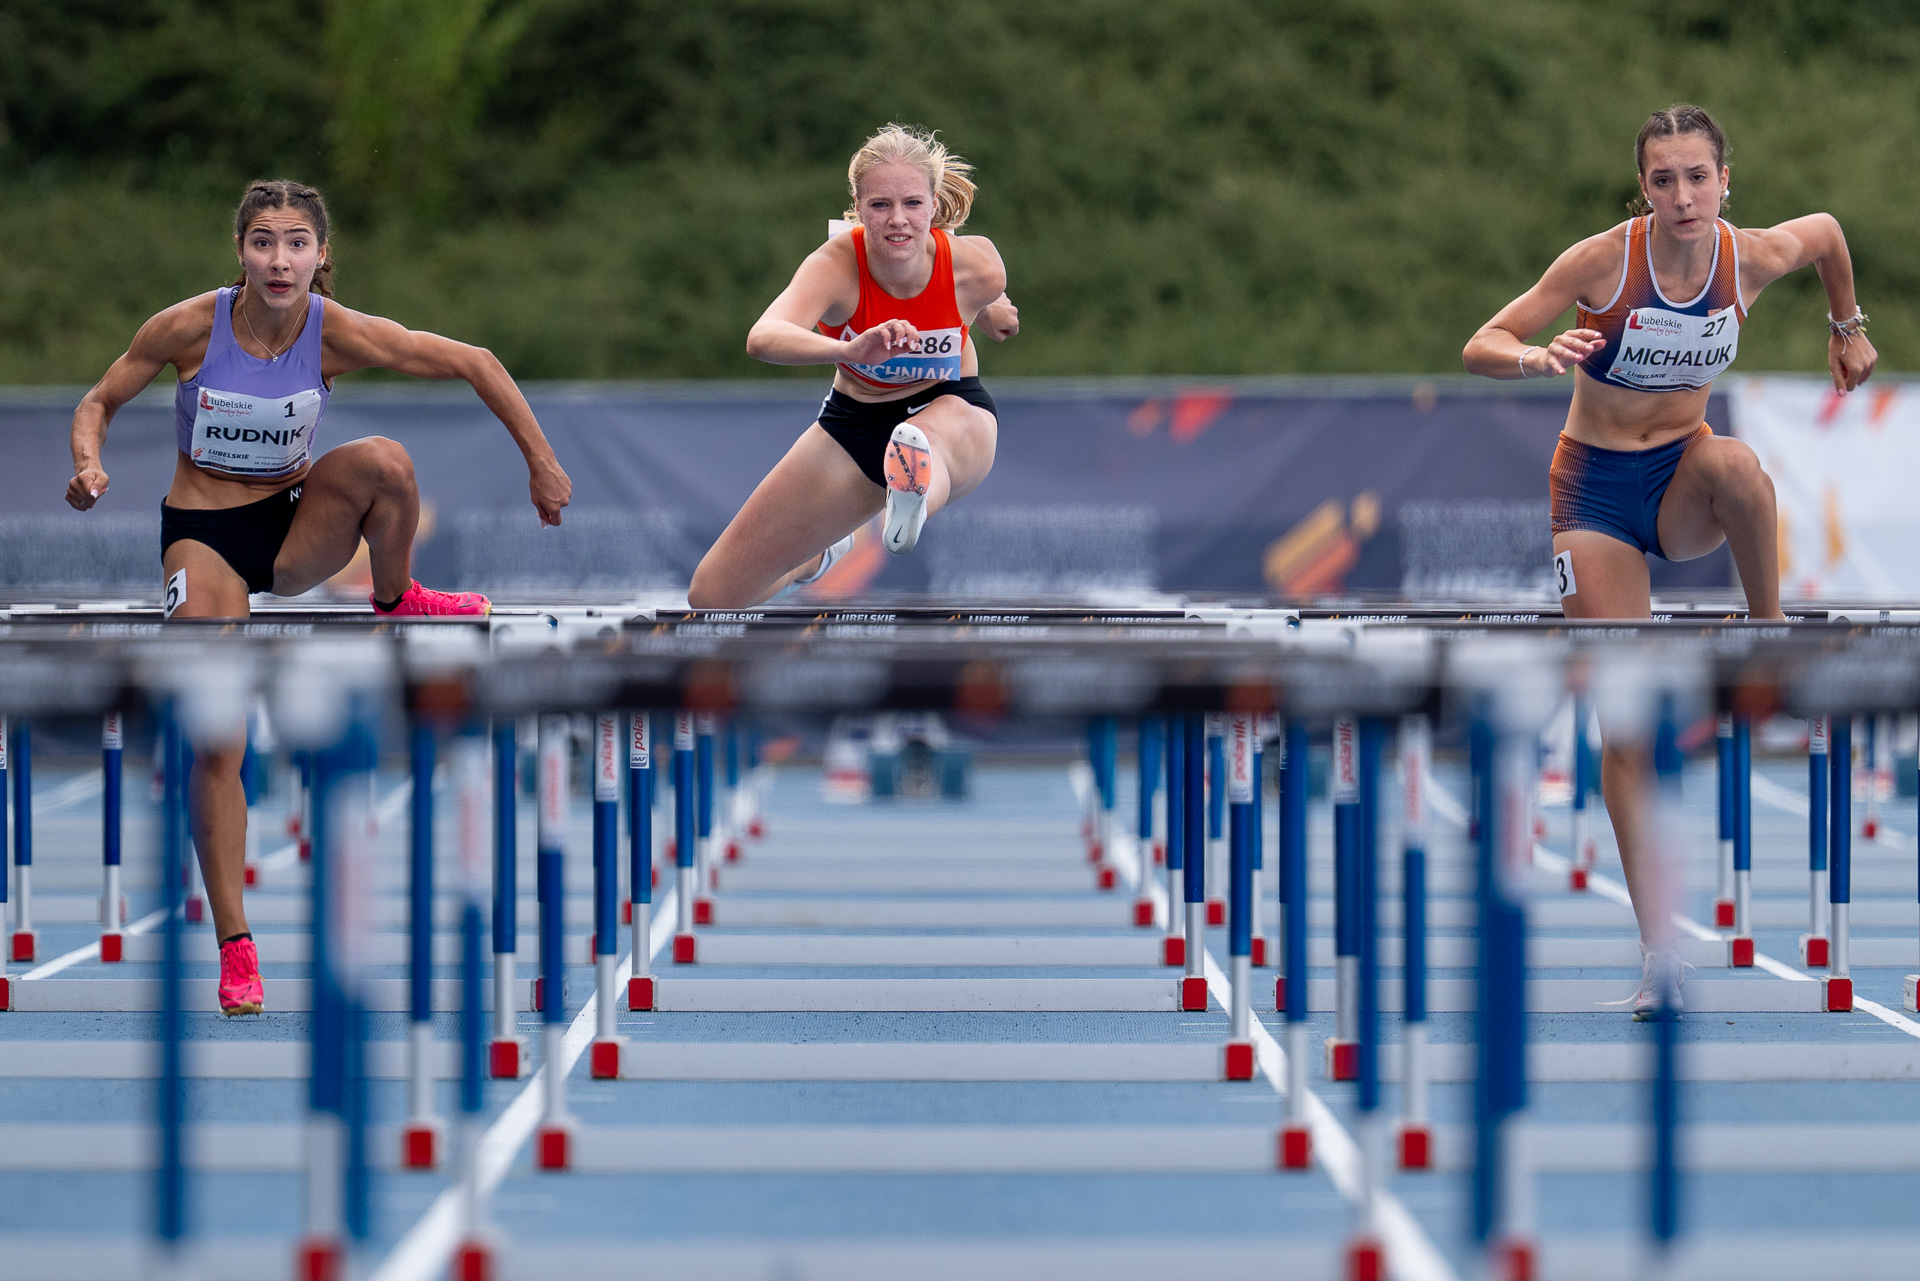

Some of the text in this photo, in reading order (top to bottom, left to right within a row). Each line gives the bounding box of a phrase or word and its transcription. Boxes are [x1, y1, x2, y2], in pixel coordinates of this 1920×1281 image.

[1641, 315, 1682, 329] lubelskie
[1701, 316, 1727, 337] 27
[1622, 344, 1732, 366] MICHALUK
[211, 397, 253, 410] lubelskie
[284, 401, 296, 418] 1
[206, 424, 306, 446] RUDNIK
[208, 449, 250, 459] LUBELSKIE
[1556, 556, 1568, 594] 3
[166, 575, 179, 612] 5
[704, 612, 764, 622] LUBELSKIE
[835, 613, 896, 623] LUBELSKIE
[1478, 614, 1539, 624] LUBELSKIE
[633, 710, 646, 751] polan
